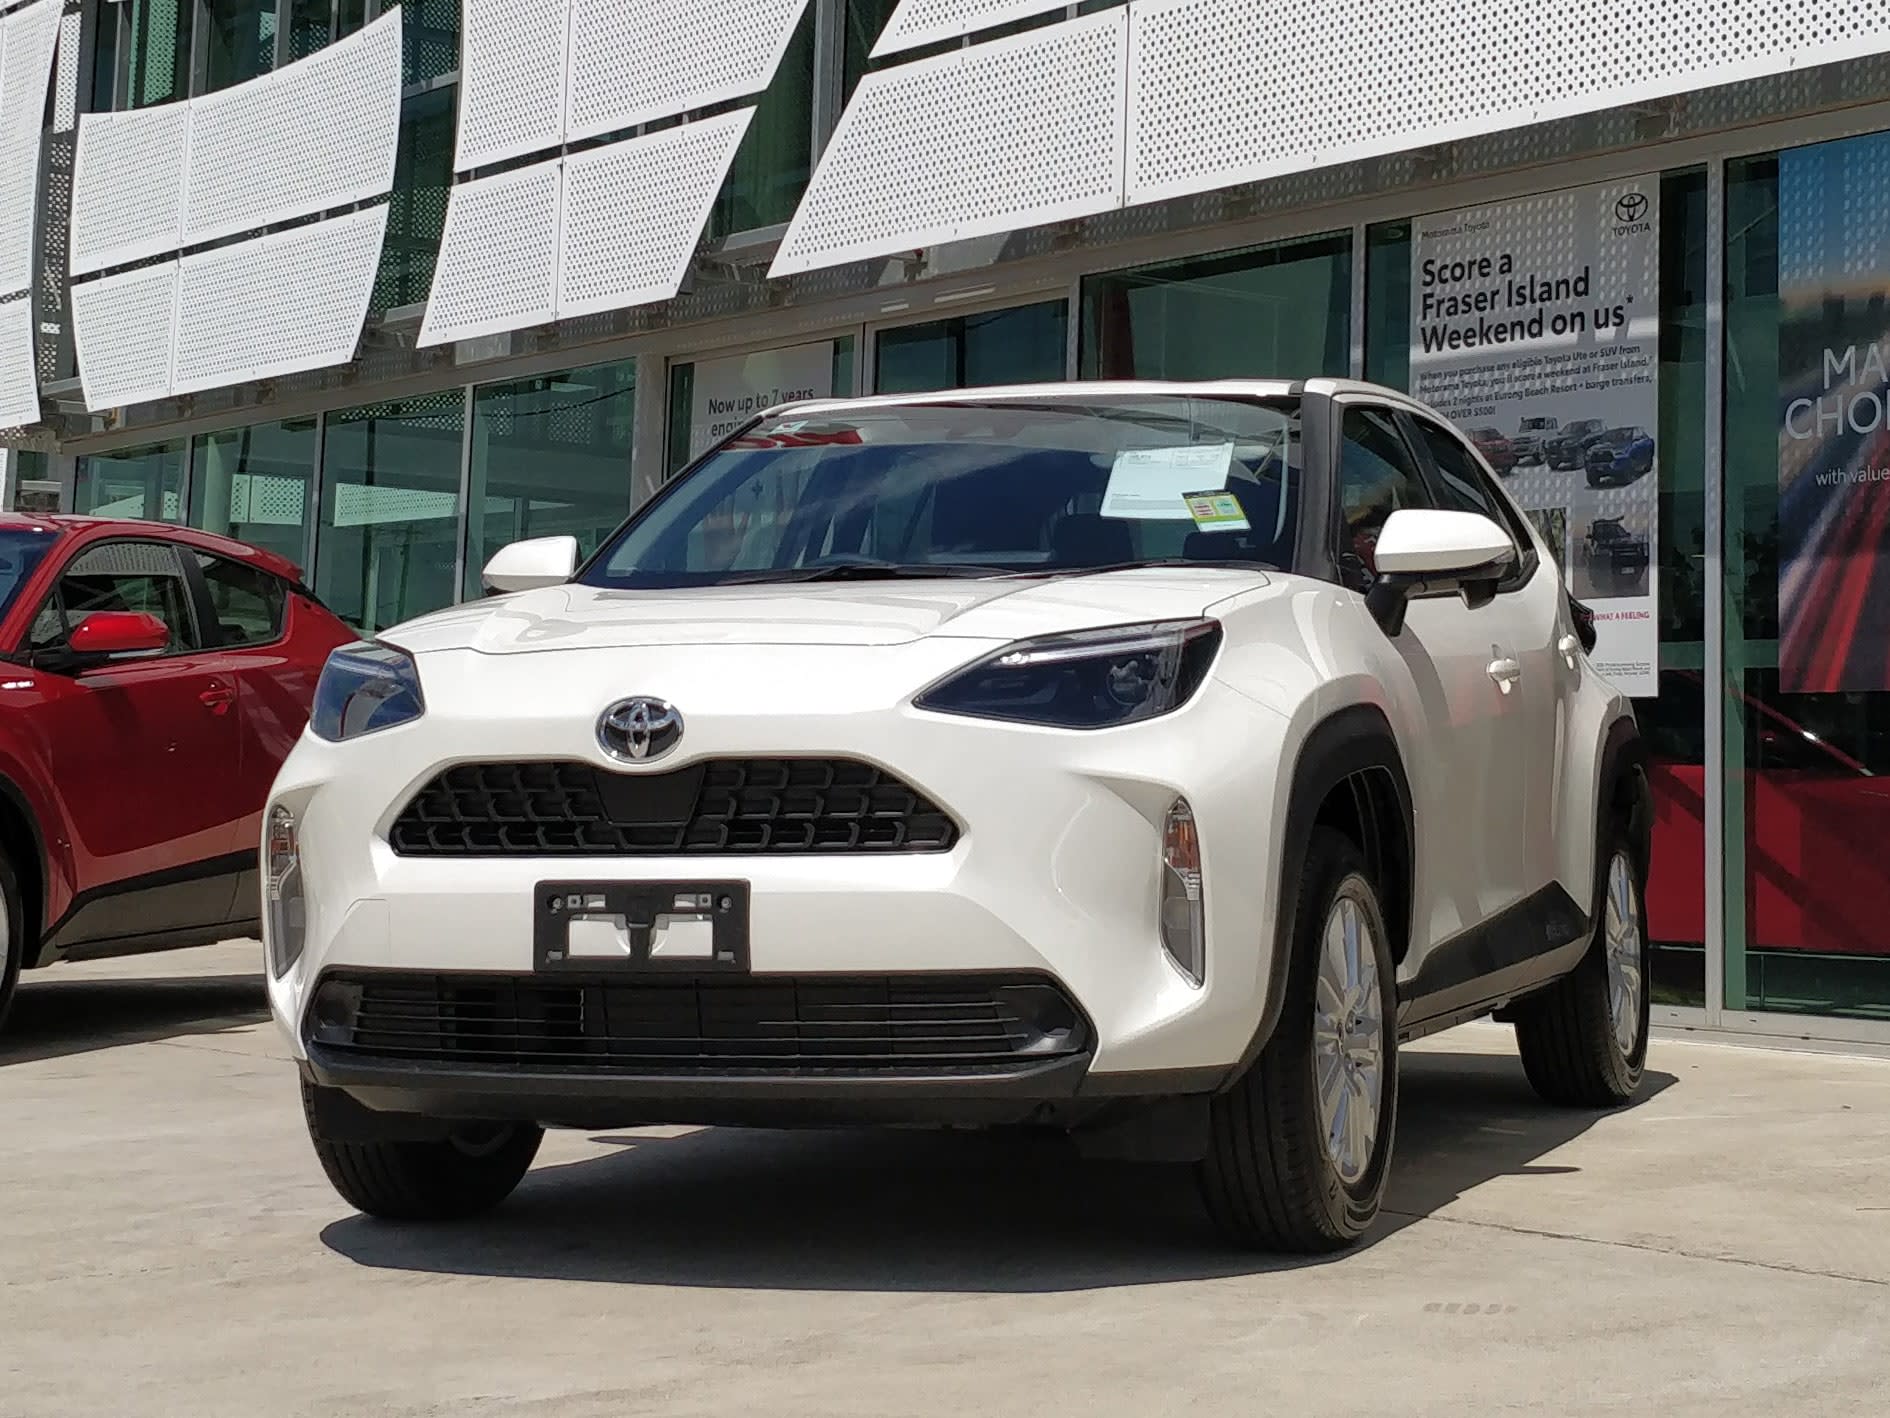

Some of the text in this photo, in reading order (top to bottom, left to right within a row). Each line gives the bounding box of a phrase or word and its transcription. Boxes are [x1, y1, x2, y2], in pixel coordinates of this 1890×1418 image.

[1464, 221, 1490, 234] Toyota
[1611, 222, 1651, 237] TOYOTA
[1422, 253, 1513, 287] Score a
[1421, 265, 1590, 321] Fraser Island
[1420, 308, 1544, 354] Weekend
[1551, 309, 1586, 336] on
[1420, 344, 1640, 380] When you purchase any eligible Toyota Ute or SUV from
[1823, 342, 1889, 390] MA
[1420, 382, 1460, 393] Motorama
[1513, 372, 1536, 383] score
[1536, 371, 1543, 379] a
[1544, 365, 1581, 378] weekend
[1582, 365, 1591, 373] at
[1592, 360, 1619, 373] Fraser
[708, 388, 814, 415] Now up to 7 years
[1459, 393, 1484, 406] nights
[1485, 393, 1494, 402] at
[1494, 390, 1524, 401] Eurong
[1525, 385, 1550, 397] Beach
[1550, 383, 1578, 394] Resort
[1585, 379, 1610, 391] barge
[1450, 408, 1473, 420] OVER
[1815, 468, 1848, 486] with
[1621, 610, 1650, 620] FEELING
